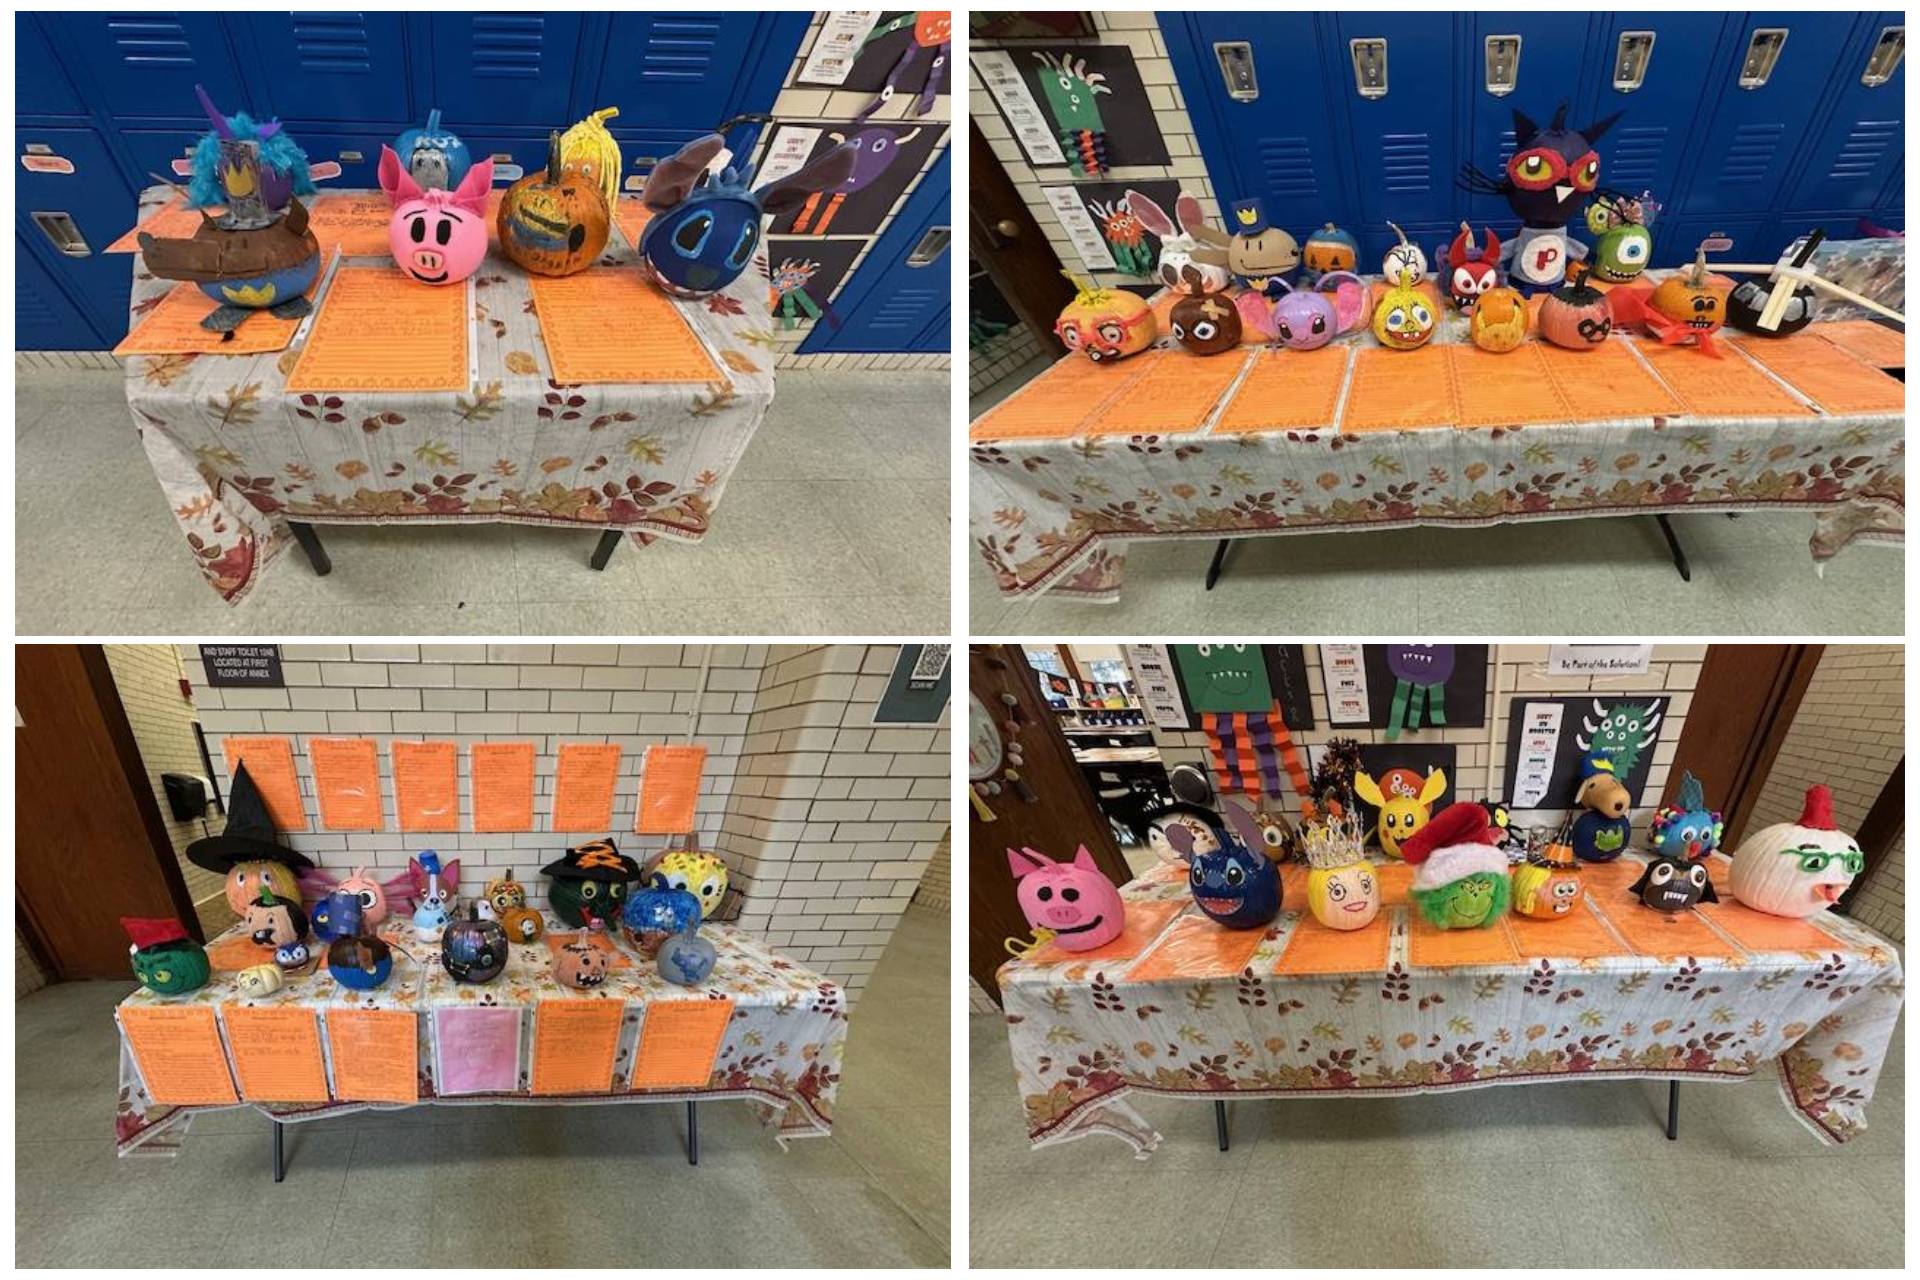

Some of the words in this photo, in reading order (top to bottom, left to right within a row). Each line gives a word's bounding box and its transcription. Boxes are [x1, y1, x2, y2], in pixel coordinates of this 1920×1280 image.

[237, 647, 258, 657] TOILET
[214, 658, 242, 667] LOCATED
[1572, 659, 1588, 669] Part
[217, 669, 239, 678] FLOOR
